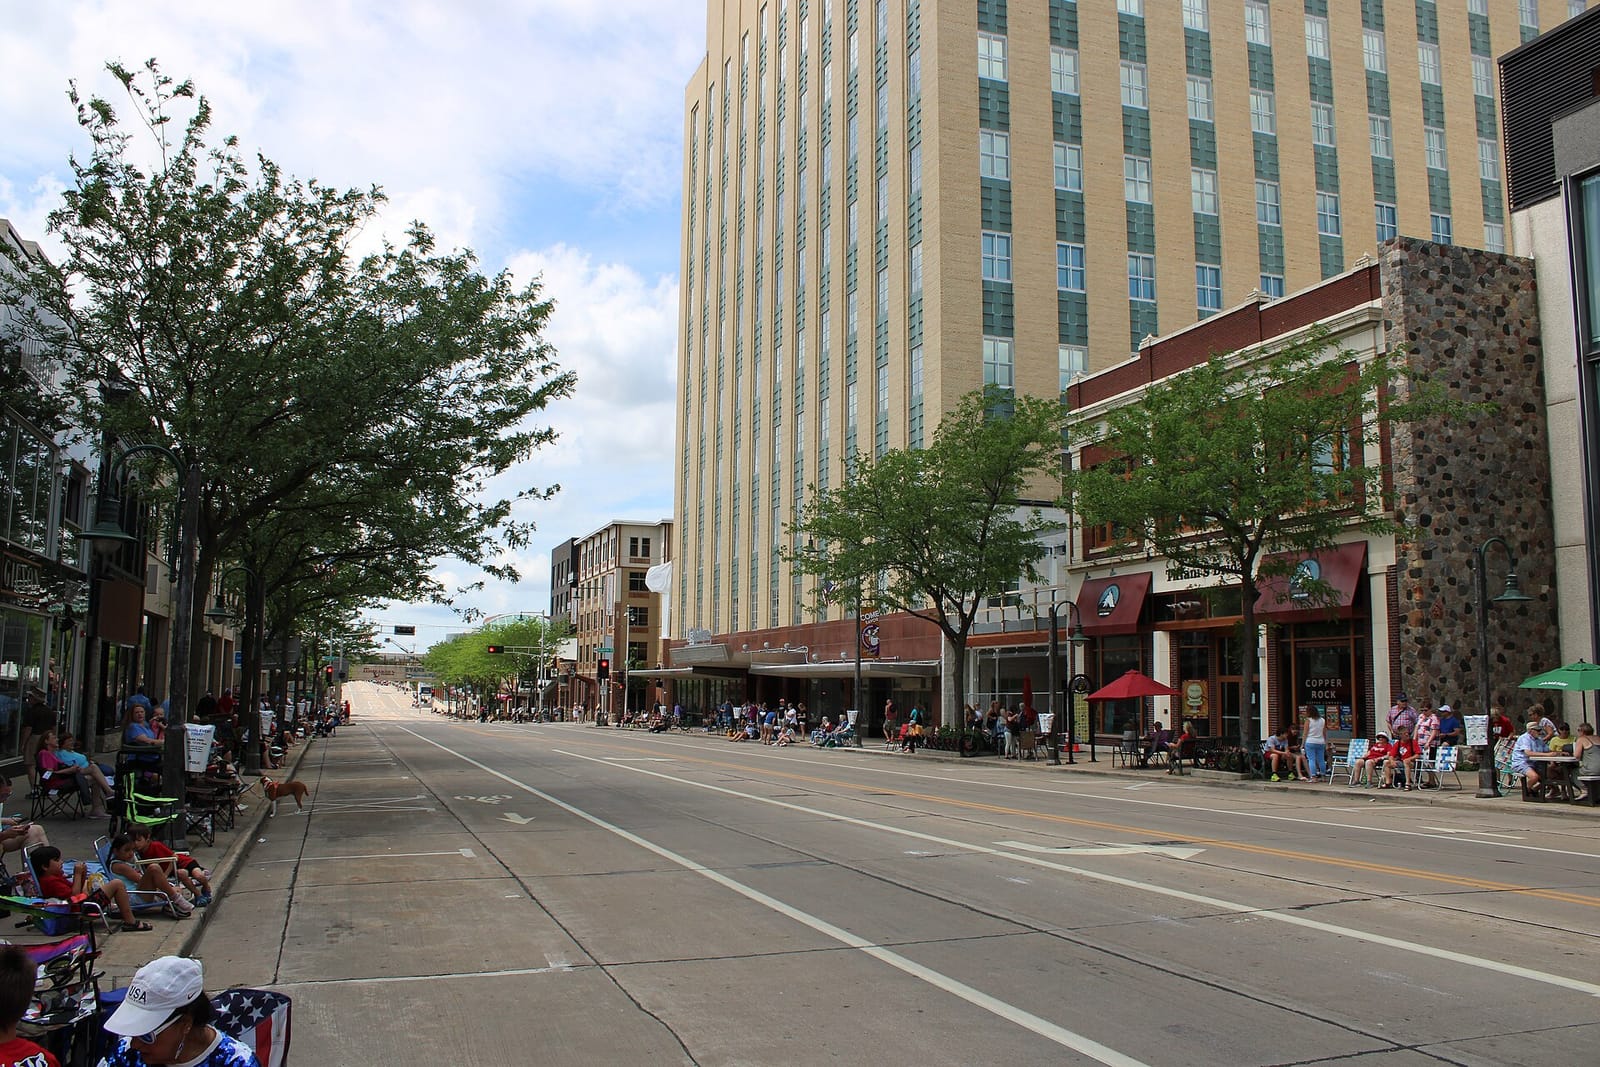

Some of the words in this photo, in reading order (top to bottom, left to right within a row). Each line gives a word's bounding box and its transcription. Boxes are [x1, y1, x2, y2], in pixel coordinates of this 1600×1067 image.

[861, 611, 880, 621] COME
[1305, 679, 1342, 687] COPPER
[1311, 690, 1336, 699] ROCK
[129, 985, 147, 1004] USA
